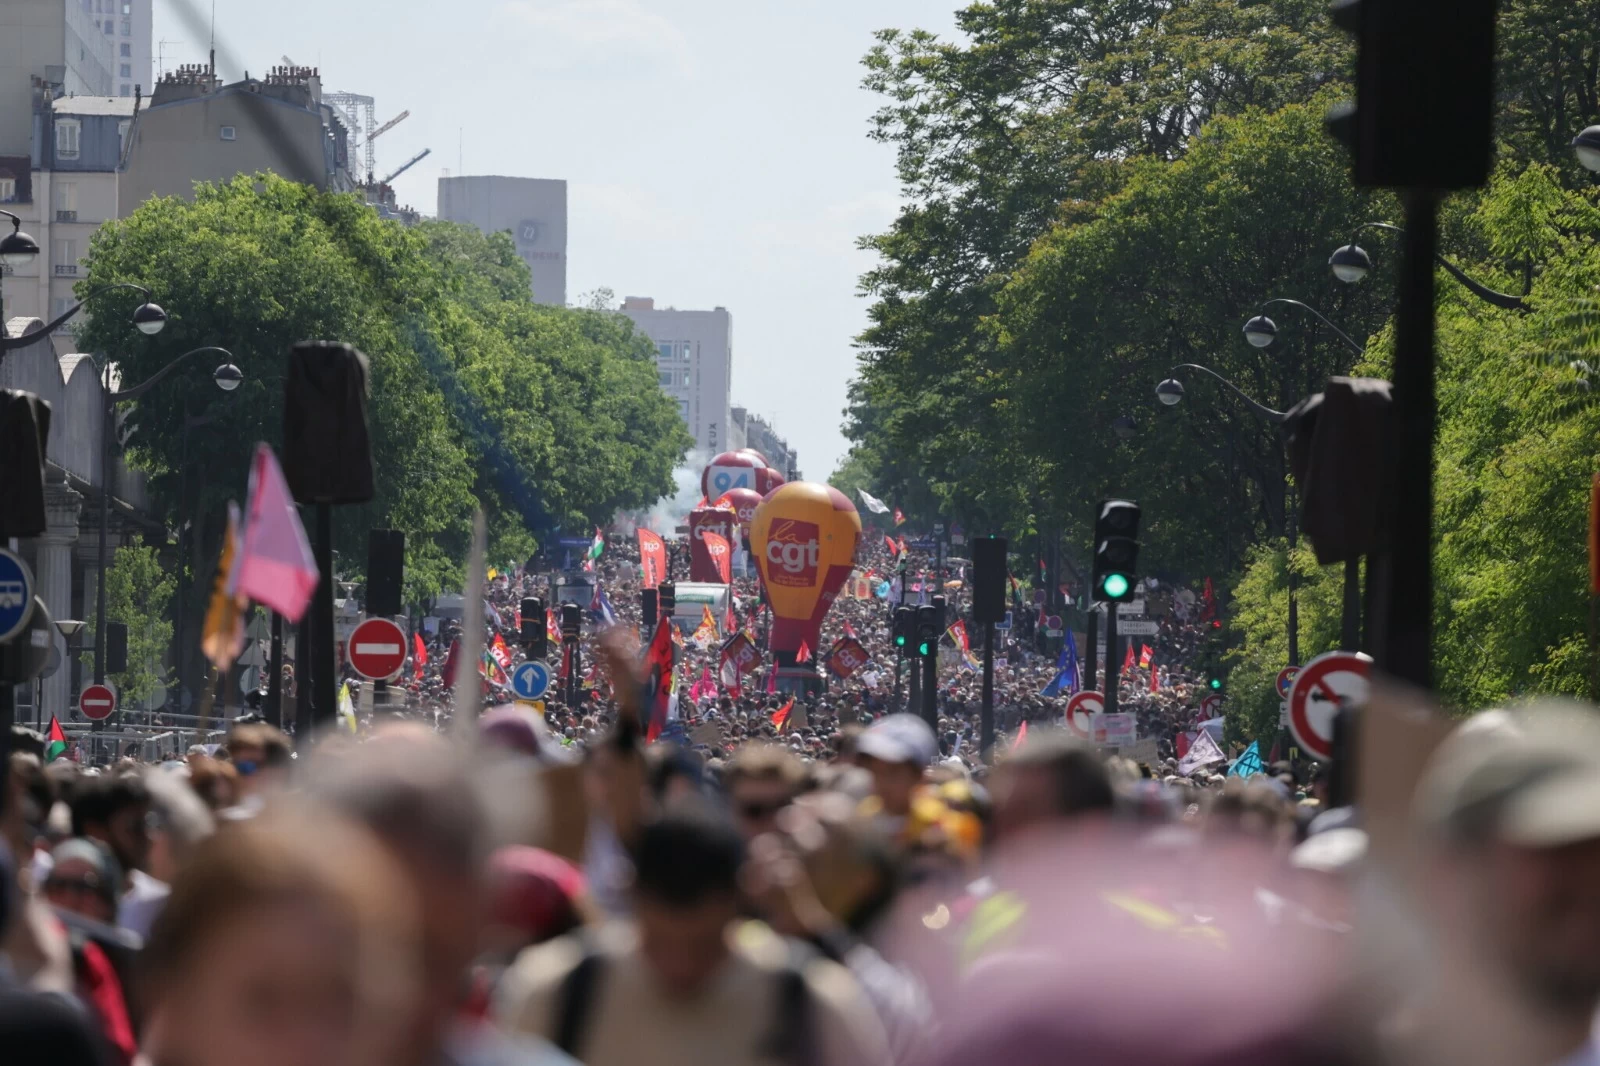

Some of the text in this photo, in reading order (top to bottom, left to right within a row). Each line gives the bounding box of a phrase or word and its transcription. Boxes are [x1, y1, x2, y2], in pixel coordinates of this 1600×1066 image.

[738, 508, 753, 522] cg
[766, 538, 820, 573] cgt
[838, 649, 861, 670] cgt
